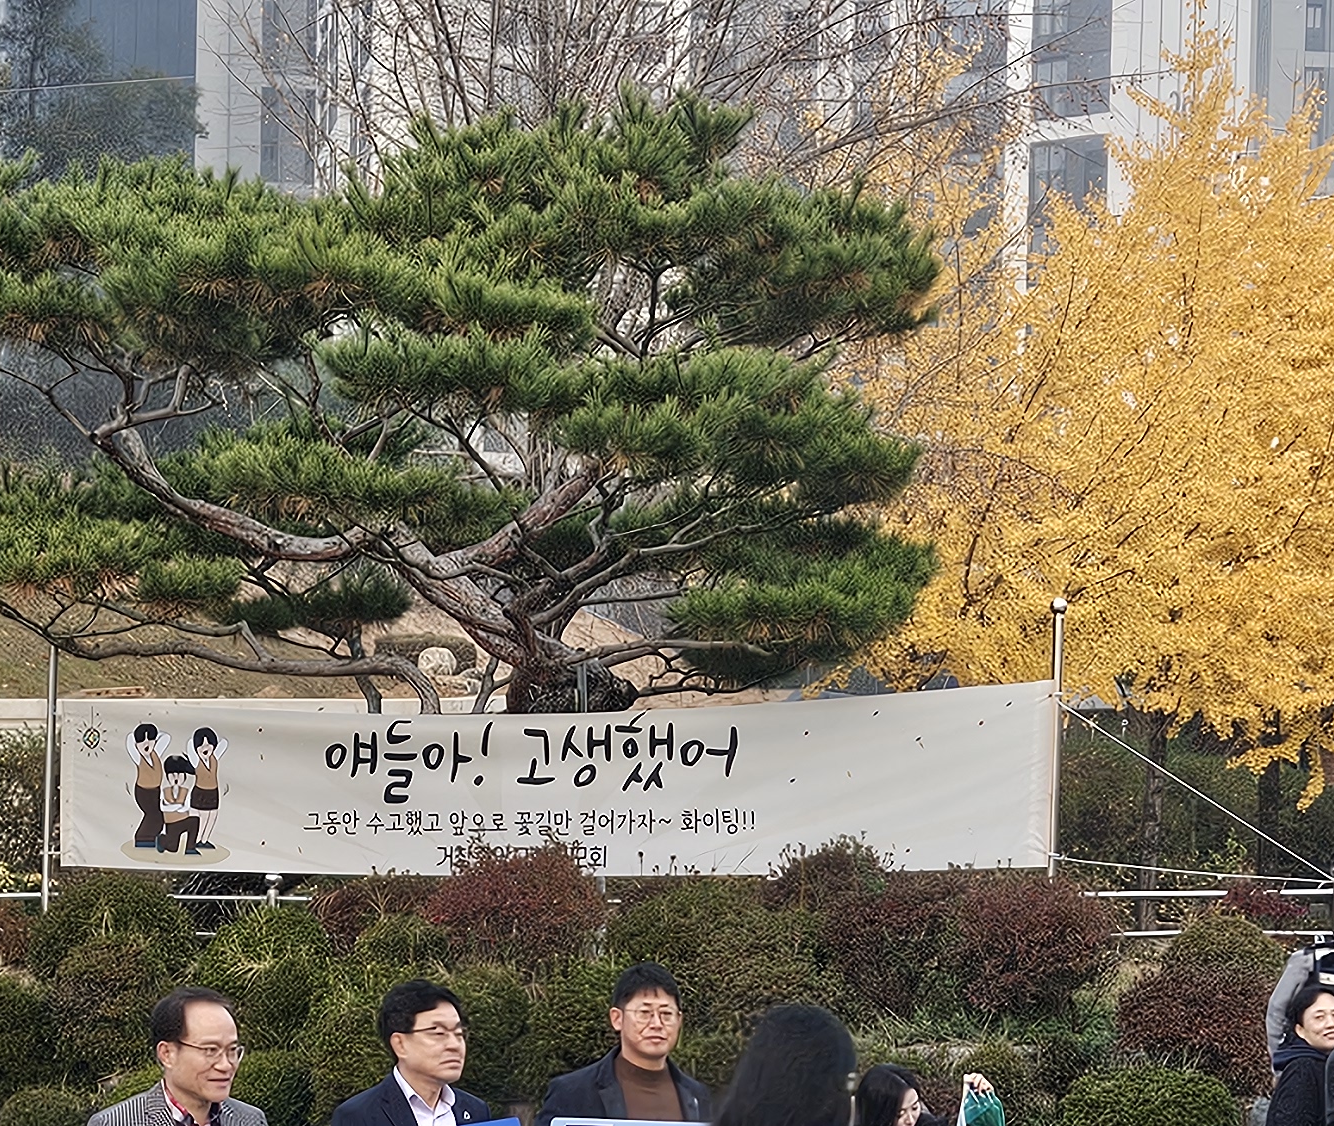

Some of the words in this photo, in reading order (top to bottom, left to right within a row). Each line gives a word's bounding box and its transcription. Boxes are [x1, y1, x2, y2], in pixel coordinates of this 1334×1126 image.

[324, 719, 493, 804] 얘들아!
[516, 708, 739, 792] 고생했어
[303, 811, 359, 835] 그동안
[366, 810, 443, 836] 수고했고
[449, 810, 508, 836] 앞으로
[514, 809, 572, 836] 꽃길만
[579, 808, 672, 836] 걸어가자~
[680, 808, 756, 835] 화이팅!!
